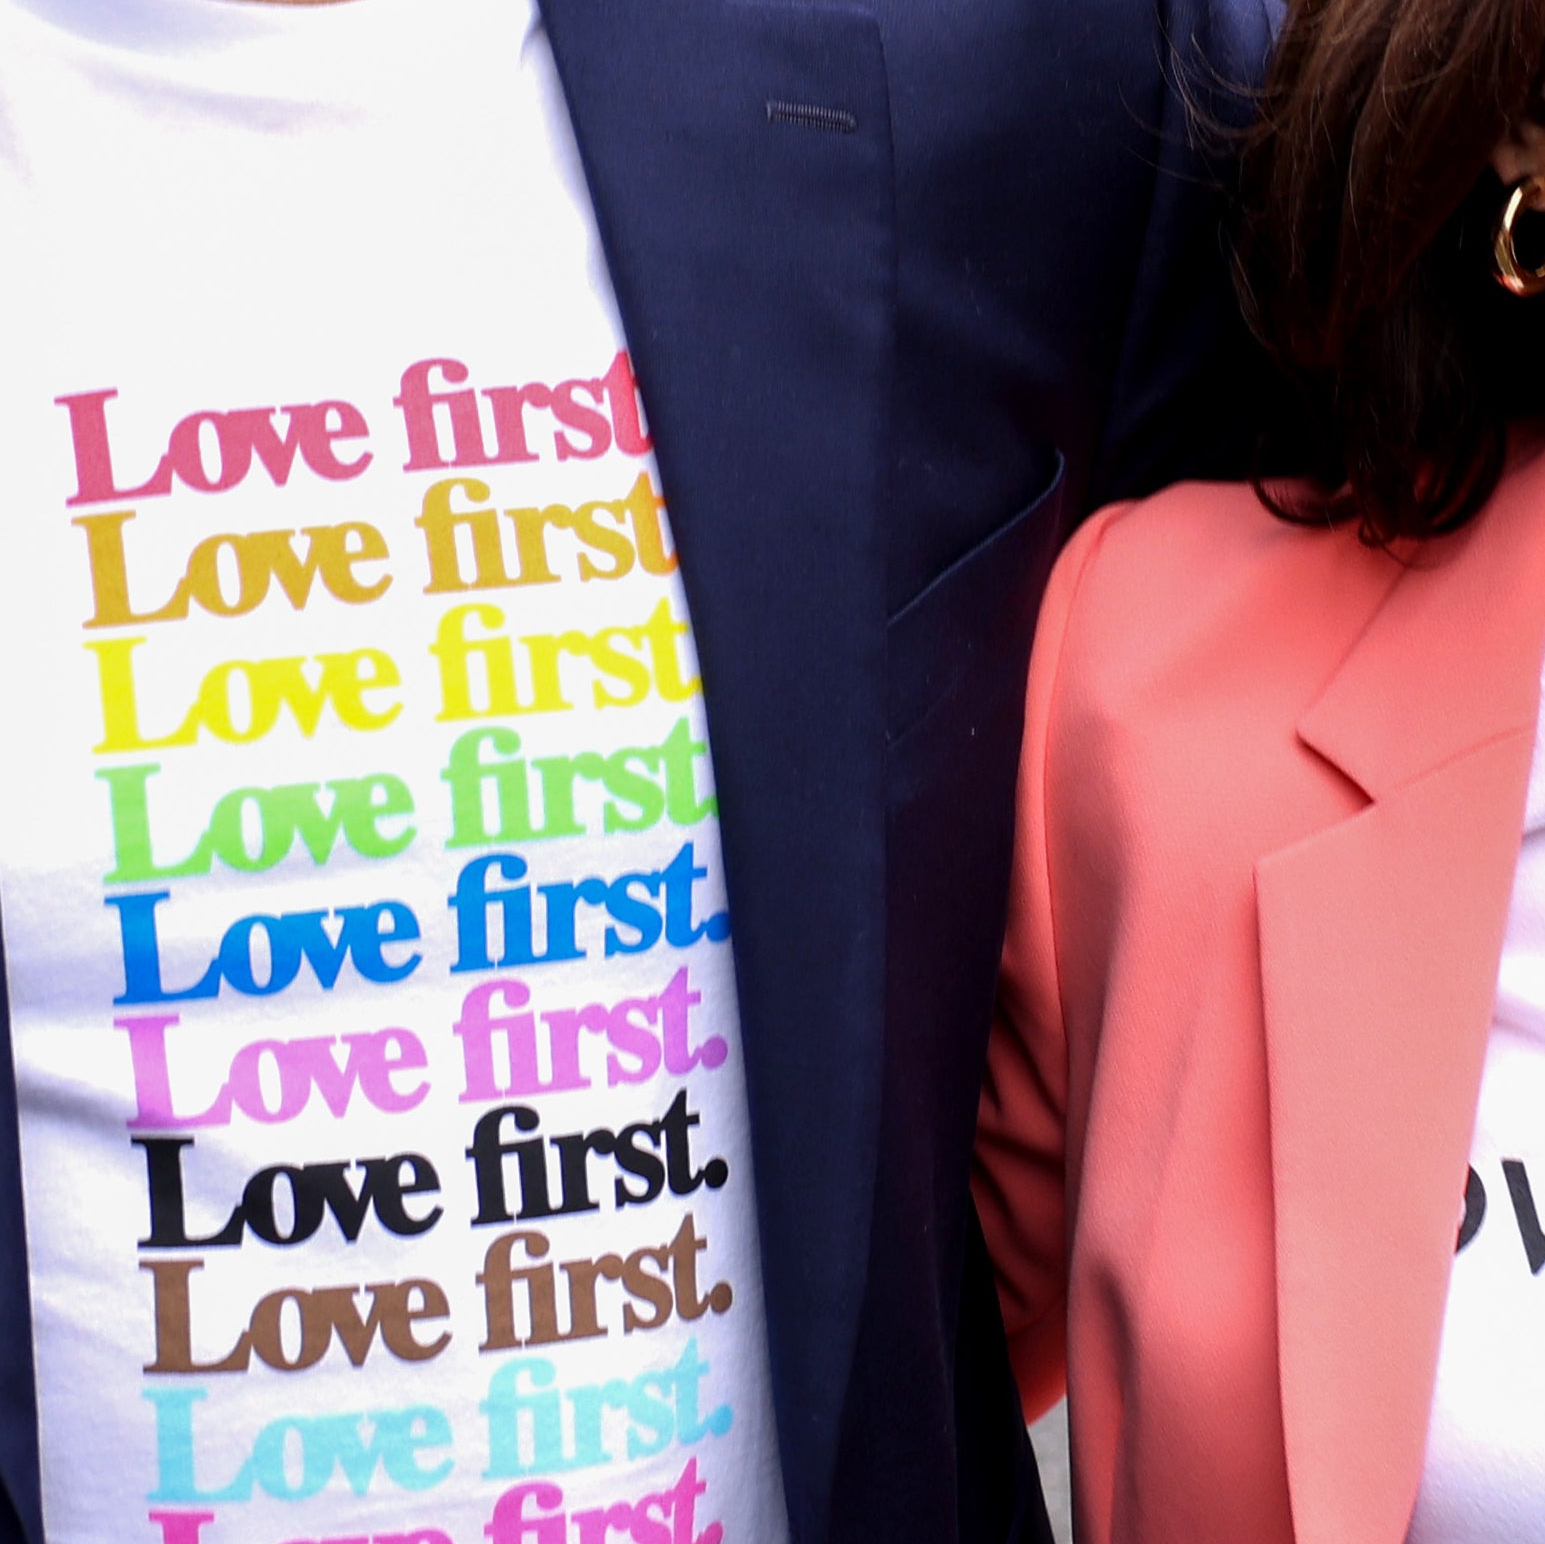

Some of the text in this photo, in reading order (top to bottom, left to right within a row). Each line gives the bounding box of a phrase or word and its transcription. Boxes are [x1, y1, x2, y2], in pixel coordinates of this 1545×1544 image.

[54, 387, 373, 508] Love
[71, 510, 393, 629] Love
[82, 636, 405, 755] Love
[94, 764, 416, 884] Love
[104, 842, 729, 1006] Love first.
[113, 966, 729, 1130] Love first.
[130, 1088, 730, 1248] Love first.
[138, 1212, 734, 1374] Love first.
[142, 1336, 733, 1503] Love first.
